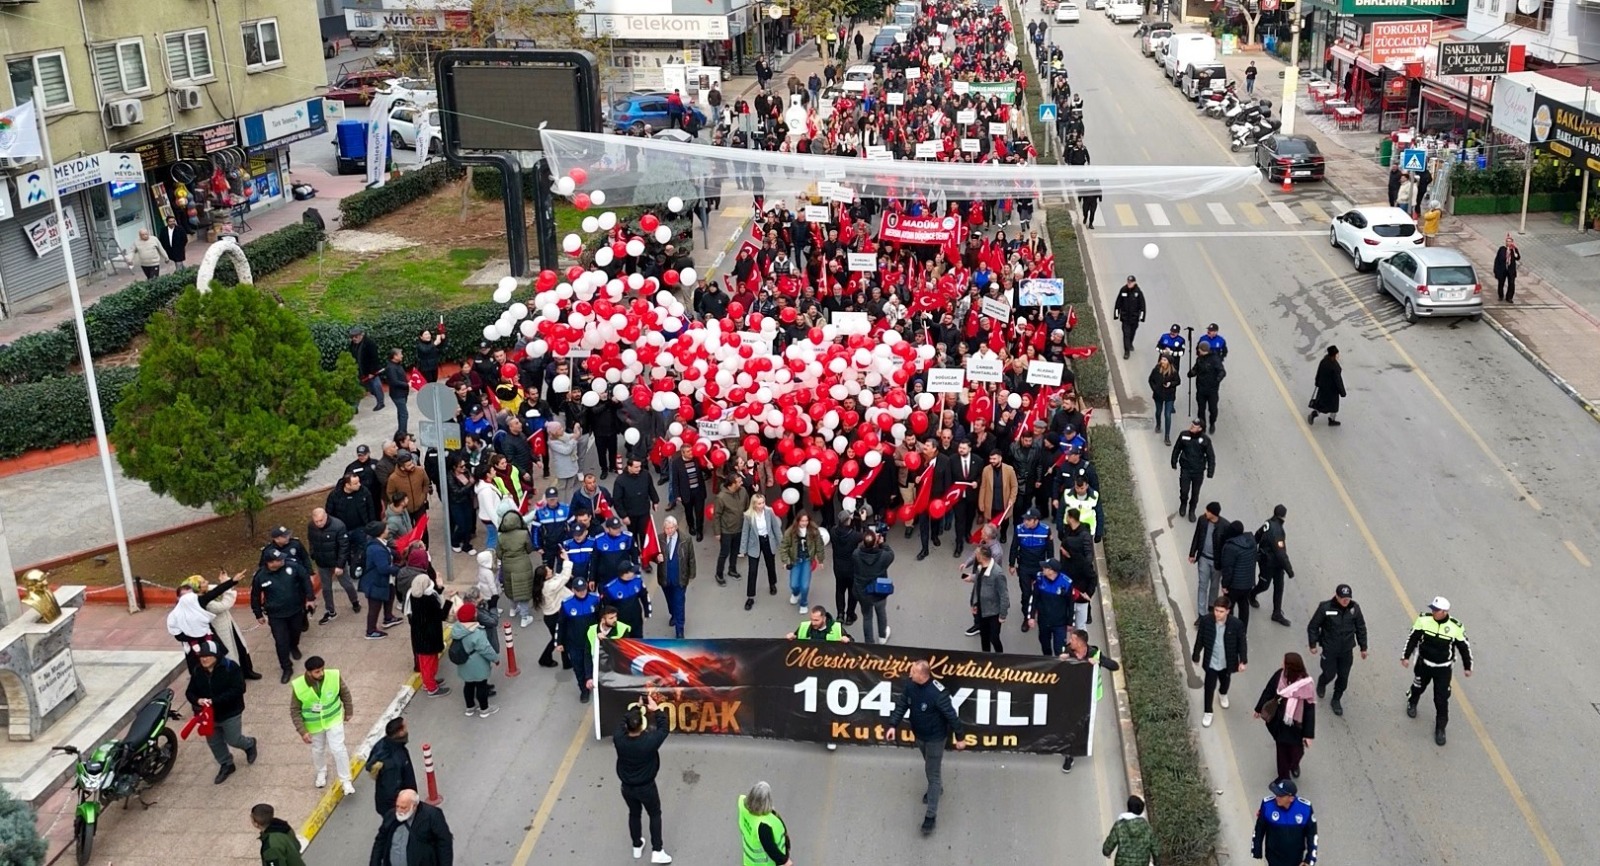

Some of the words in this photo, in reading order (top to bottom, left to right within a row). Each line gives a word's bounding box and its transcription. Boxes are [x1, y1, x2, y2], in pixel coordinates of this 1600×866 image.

[624, 16, 700, 30] Telekom
[1376, 24, 1428, 34] TOROSLAR
[1444, 45, 1480, 54] SAKURA
[1448, 53, 1504, 67] ÇİÇEKÇİLİK
[1556, 129, 1584, 150] BAKLAVA
[1584, 141, 1590, 152] &
[54, 156, 100, 179] MEYDAN
[902, 220, 939, 229] MADÜM
[926, 655, 1060, 685] Kurtuluşunun
[657, 700, 742, 734] OCAK
